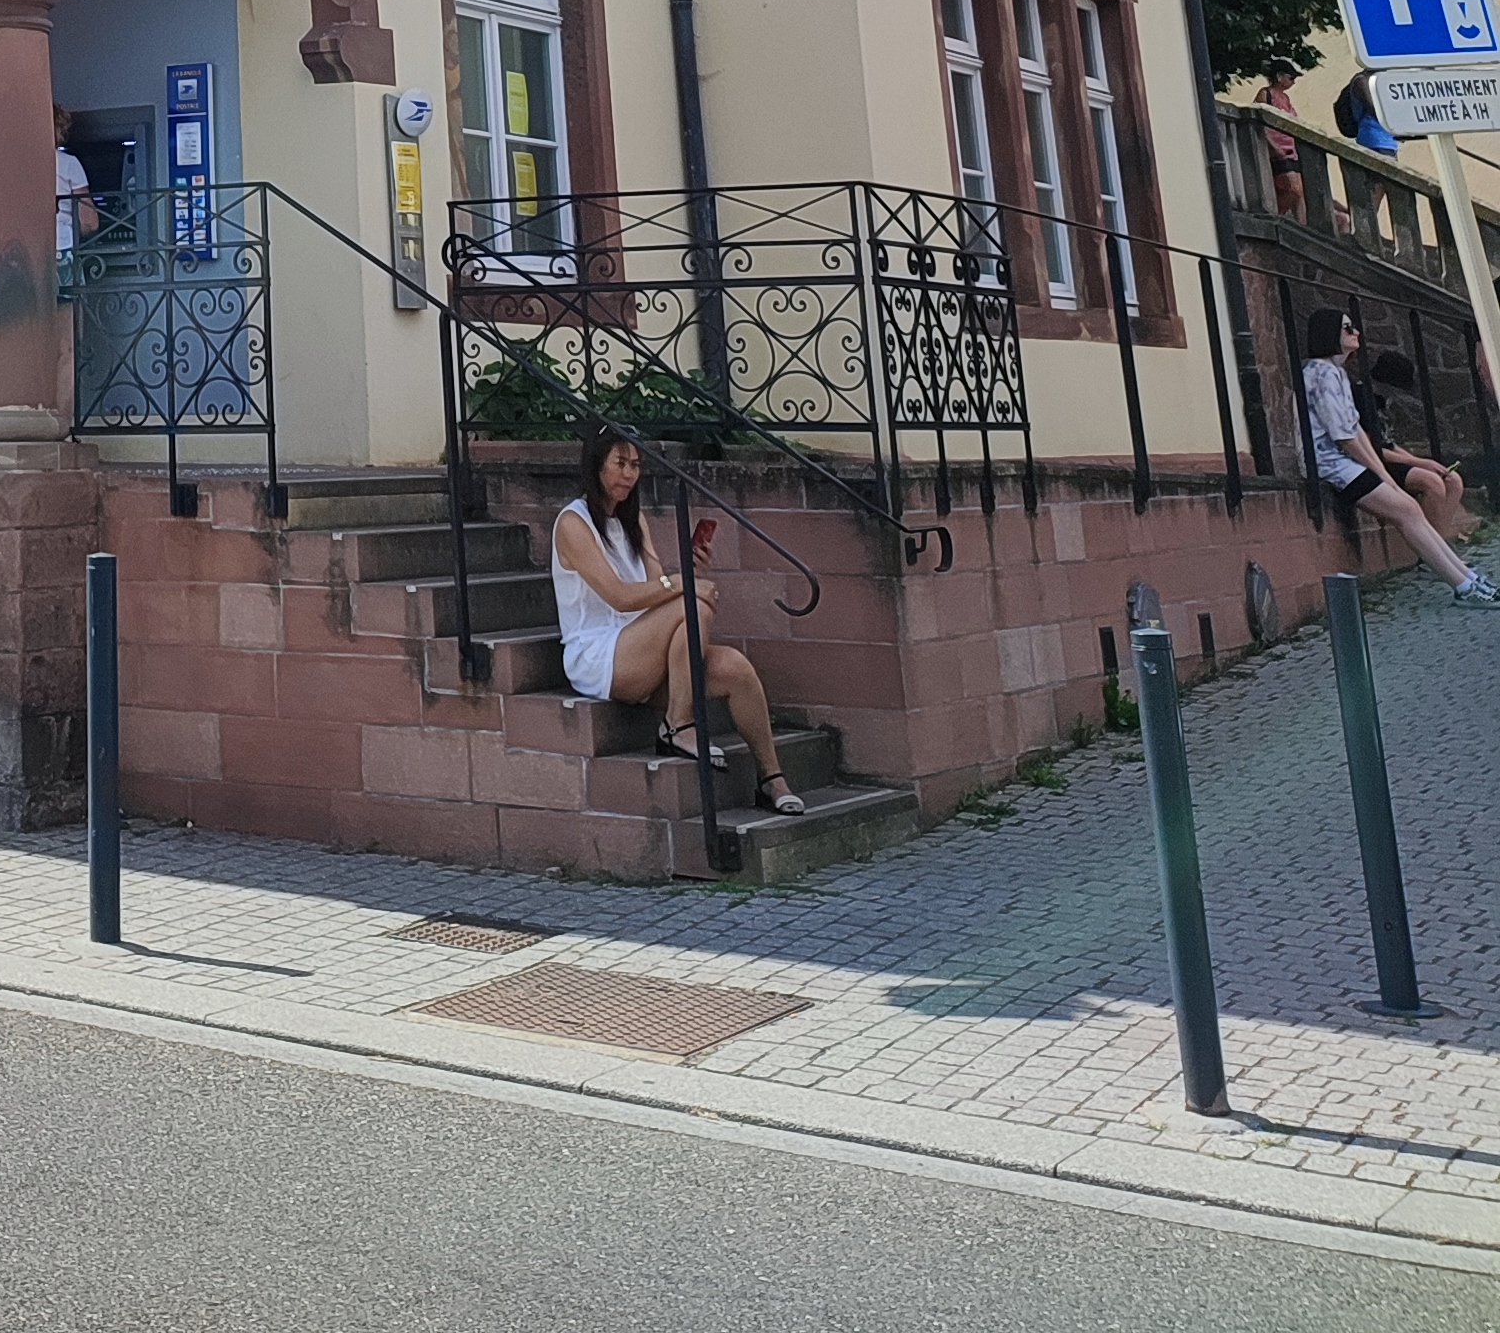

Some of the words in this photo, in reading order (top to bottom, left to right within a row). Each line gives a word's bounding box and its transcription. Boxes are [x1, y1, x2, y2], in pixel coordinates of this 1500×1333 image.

[1388, 78, 1498, 101] STATIONNEMENT
[1413, 99, 1460, 123] LIMITÉ
[1460, 99, 1472, 121] À
[1472, 102, 1490, 120] 1H
